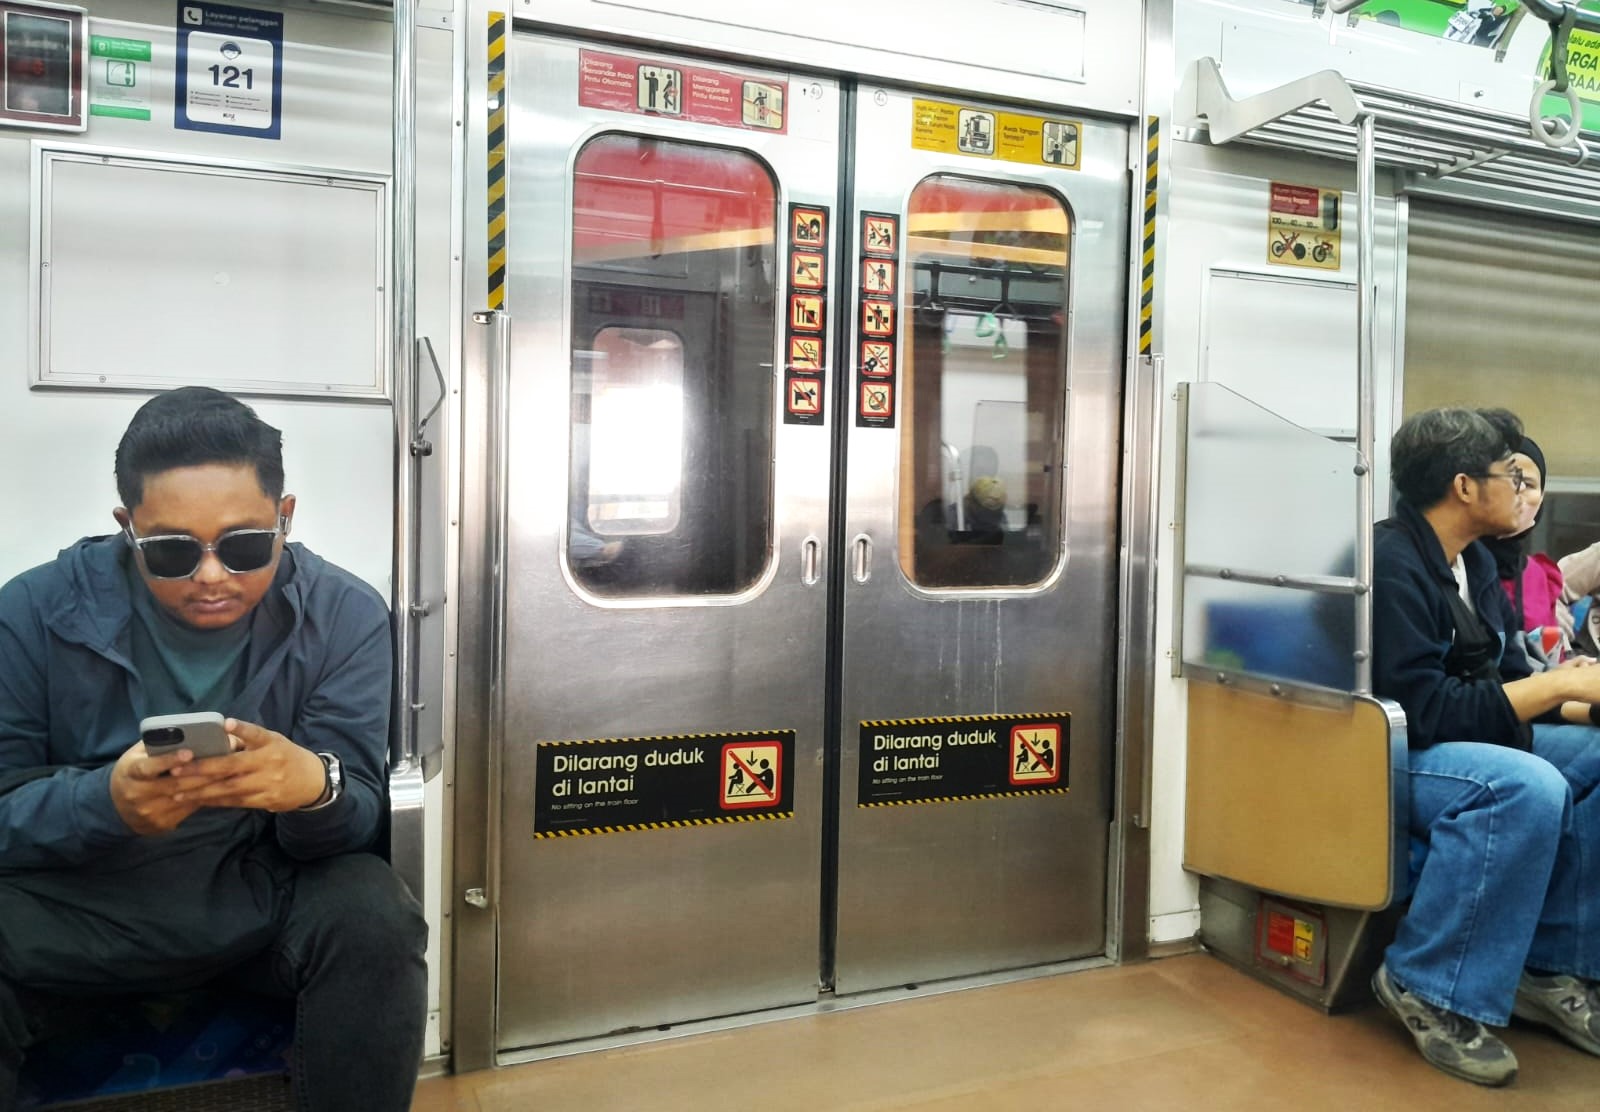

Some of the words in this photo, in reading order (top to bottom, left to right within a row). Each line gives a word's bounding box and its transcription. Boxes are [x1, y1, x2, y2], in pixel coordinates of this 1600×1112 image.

[208, 64, 253, 90] 121
[874, 734, 943, 751] Dilarang
[947, 729, 997, 746] duduk
[553, 754, 638, 773] Dilarang
[644, 747, 704, 767] duduk
[873, 756, 889, 772] di
[893, 753, 940, 771] lantai
[552, 778, 572, 797] di
[578, 774, 634, 795] lantai
